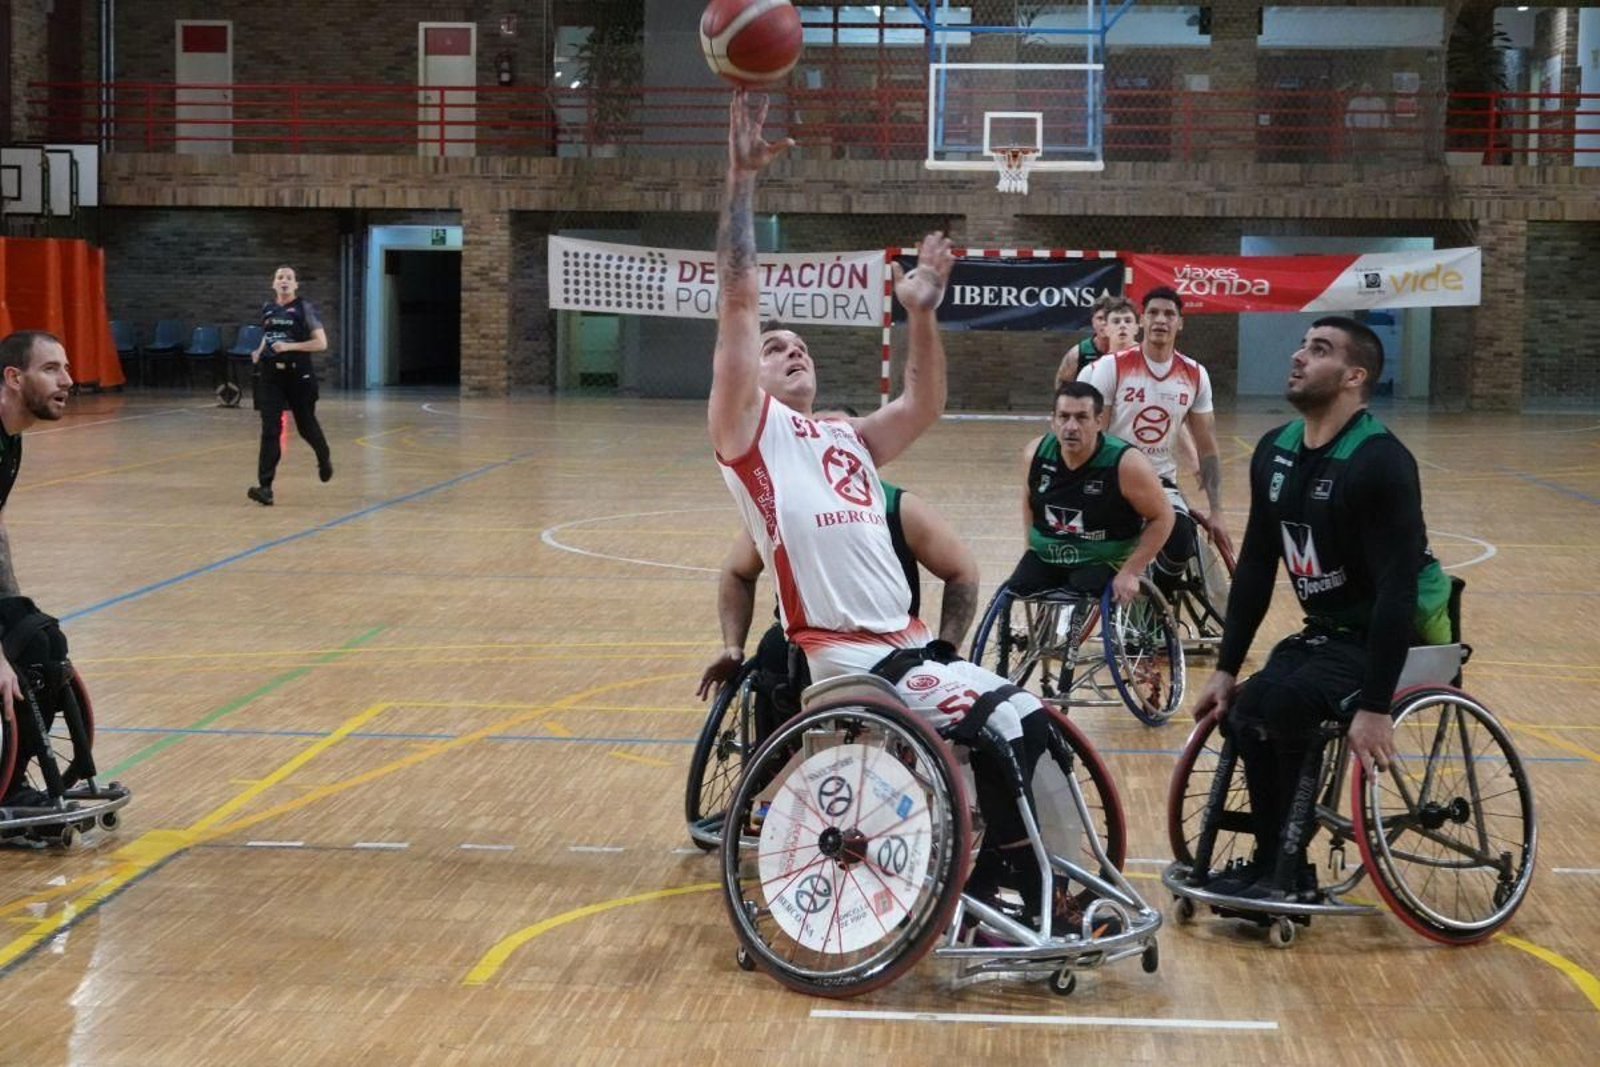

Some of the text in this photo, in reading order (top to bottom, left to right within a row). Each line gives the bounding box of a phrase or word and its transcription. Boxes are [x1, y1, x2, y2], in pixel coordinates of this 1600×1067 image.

[677, 256, 869, 290] DETACIÓN
[1389, 262, 1464, 295] vide
[676, 287, 872, 321] POEVEDRA
[1124, 387, 1145, 403] 24
[791, 415, 821, 439] 51
[1047, 543, 1079, 564] 10
